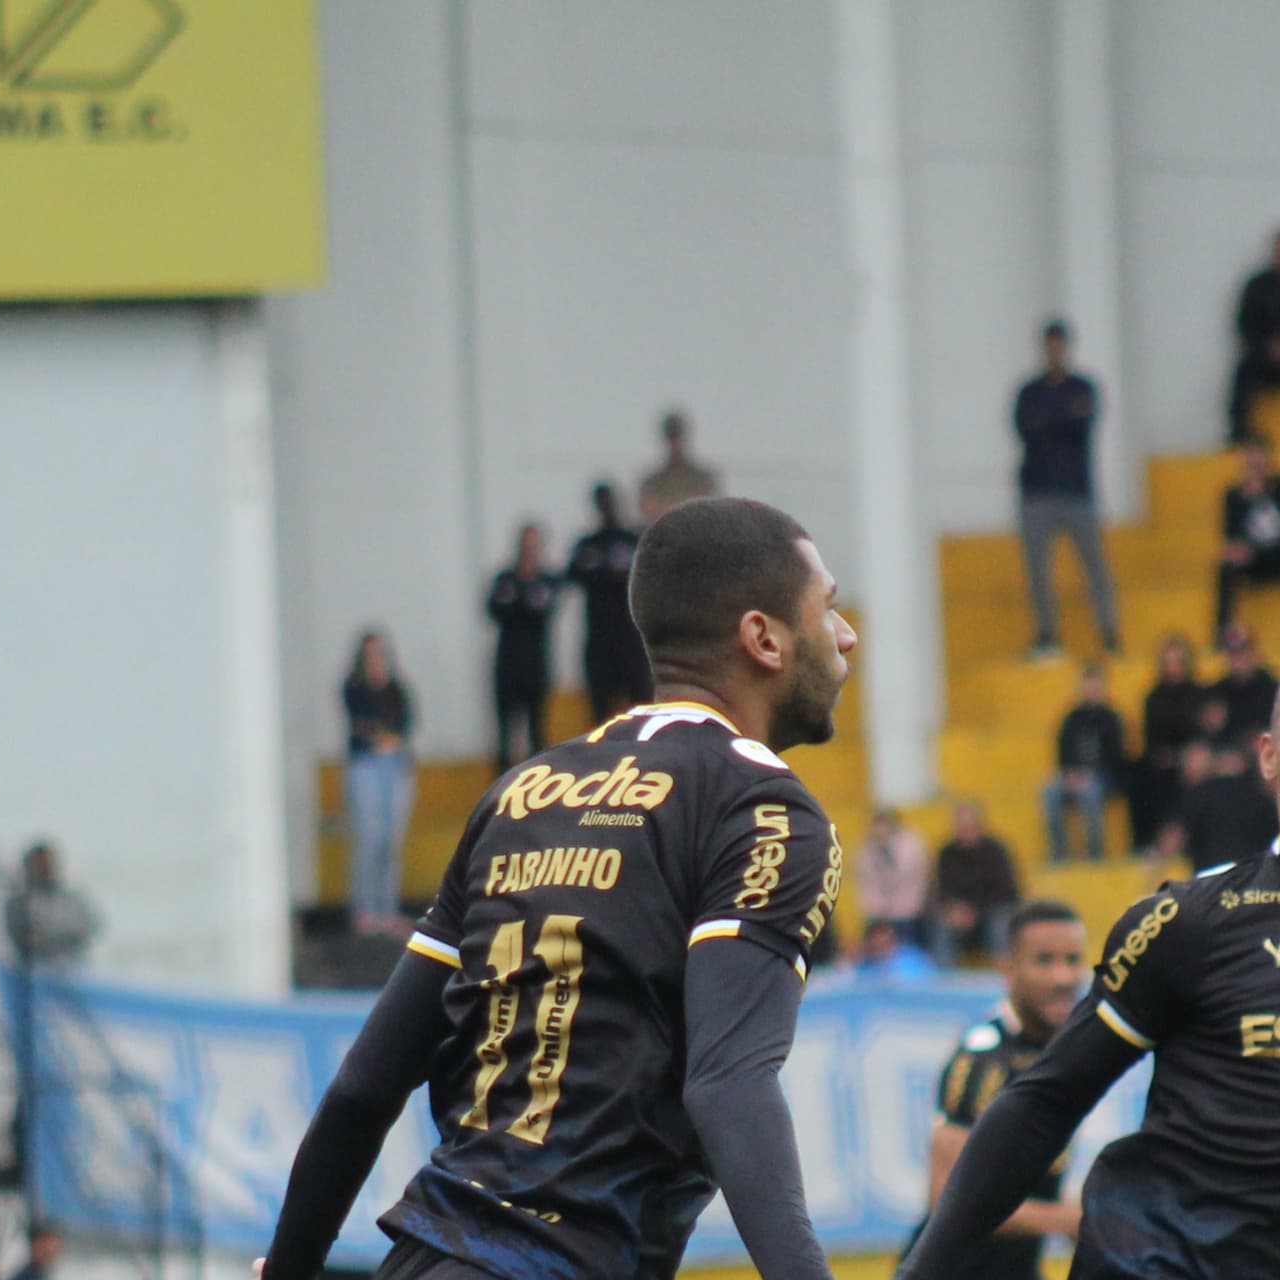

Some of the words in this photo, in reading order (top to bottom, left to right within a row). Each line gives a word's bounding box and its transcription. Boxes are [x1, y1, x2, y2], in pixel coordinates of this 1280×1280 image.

[496, 755, 674, 820] Rocha
[578, 809, 646, 827] Alimentos
[485, 847, 622, 896] FABINHO
[1103, 897, 1180, 992] unesc
[460, 915, 584, 1146] 11
